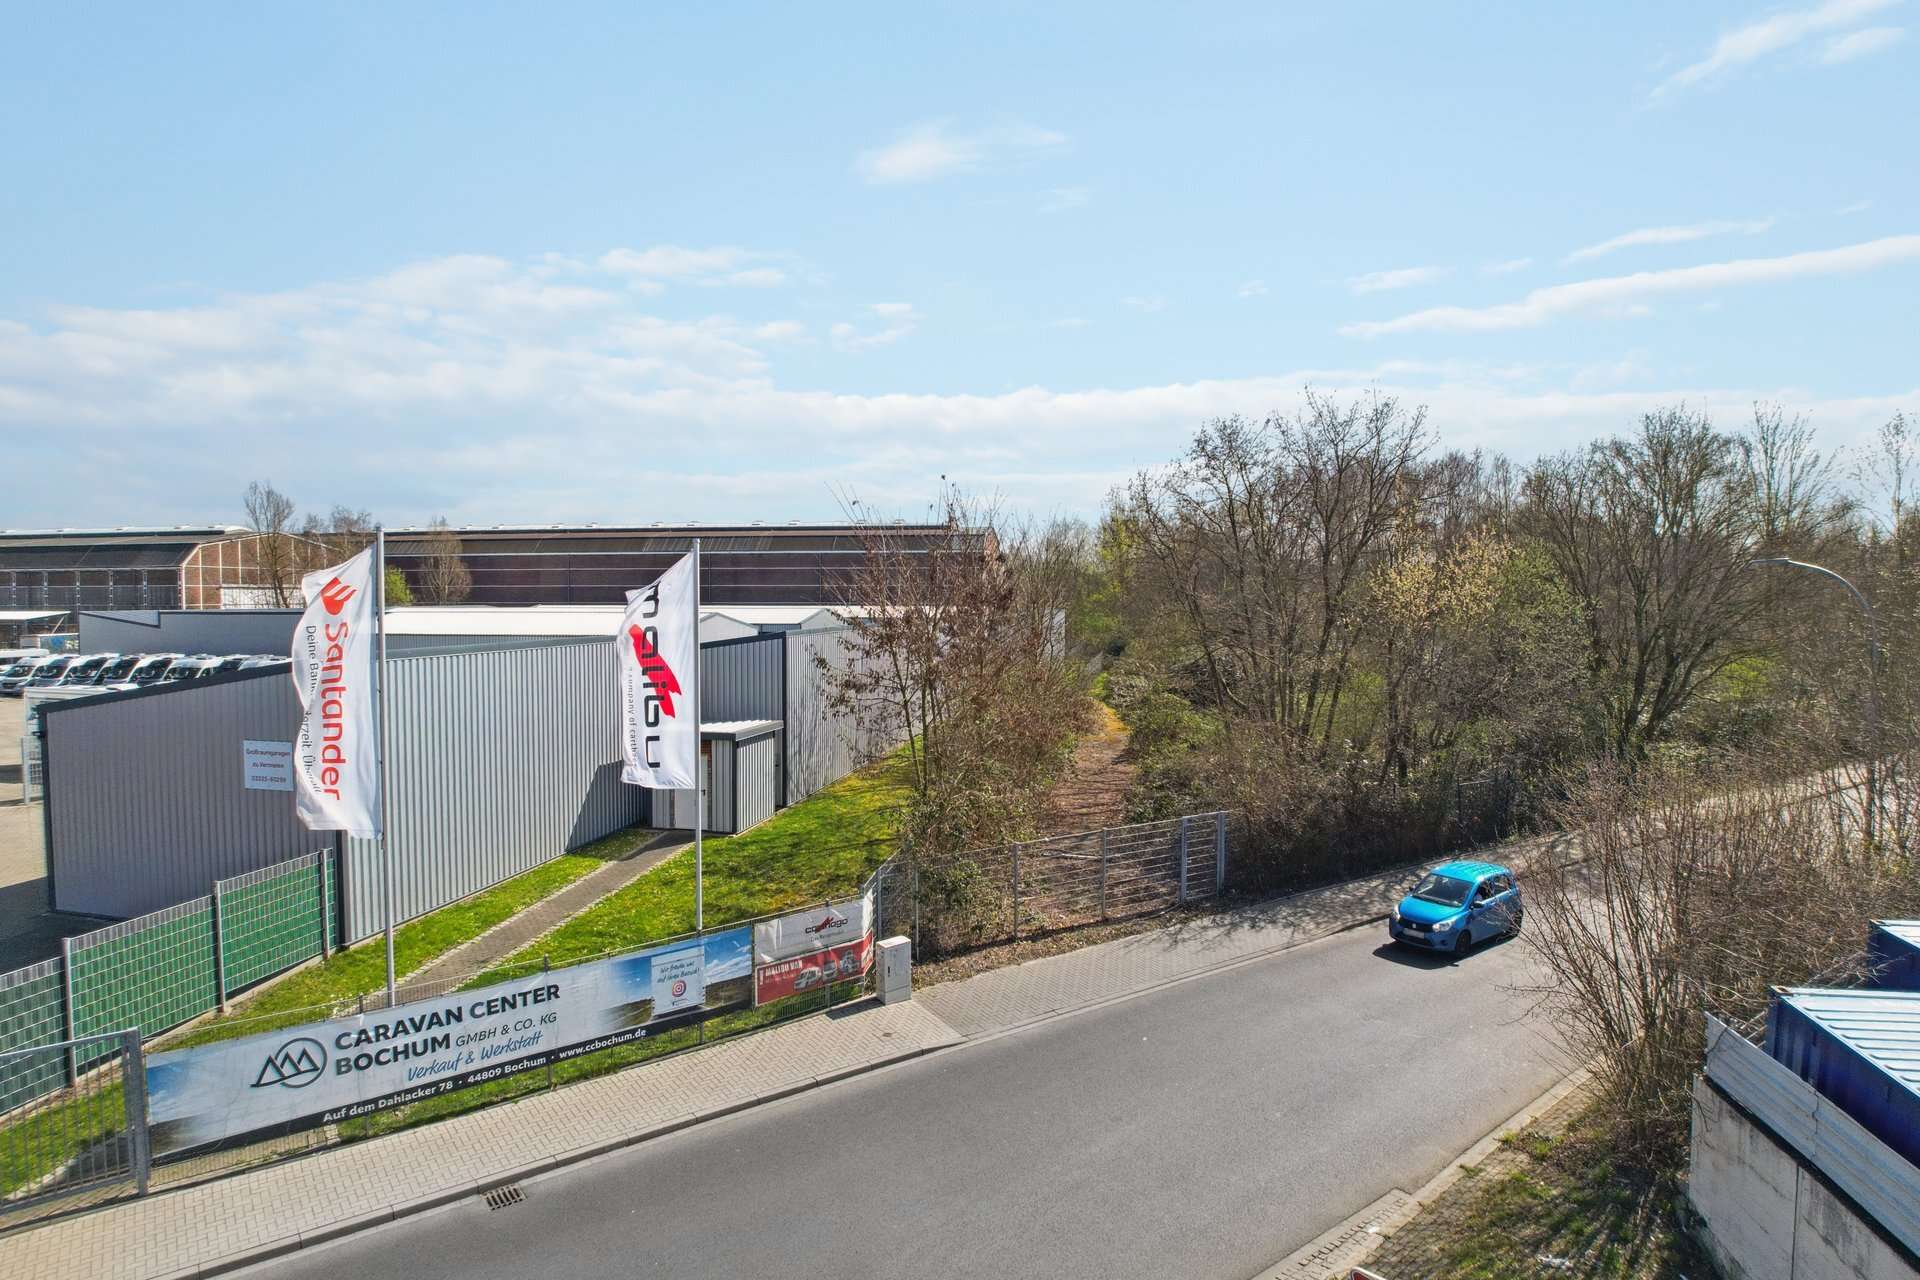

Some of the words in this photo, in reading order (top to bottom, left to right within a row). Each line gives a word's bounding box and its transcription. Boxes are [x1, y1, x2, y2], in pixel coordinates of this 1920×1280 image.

[305, 625, 319, 660] Deine
[642, 582, 667, 768] malibu
[319, 623, 349, 801] Santander
[335, 1006, 463, 1050] CARAVAN
[469, 984, 561, 1019] CENTER
[335, 1032, 451, 1076] BOCHUM
[455, 1027, 497, 1047] GMBH
[501, 1024, 510, 1036] &
[514, 1018, 536, 1032] CO.
[540, 1012, 557, 1026] KG
[323, 1108, 347, 1122] Auf
[349, 1104, 375, 1116] dem
[378, 1086, 436, 1109] Dahlacker
[439, 1081, 454, 1092] 78
[467, 1067, 502, 1084] 44809
[504, 1056, 547, 1075] Bochum
[559, 1027, 647, 1060] www.ccbochum.de
[407, 1050, 463, 1082] Verkauf
[465, 1051, 475, 1065] &
[481, 1031, 544, 1060] Werkstatt
